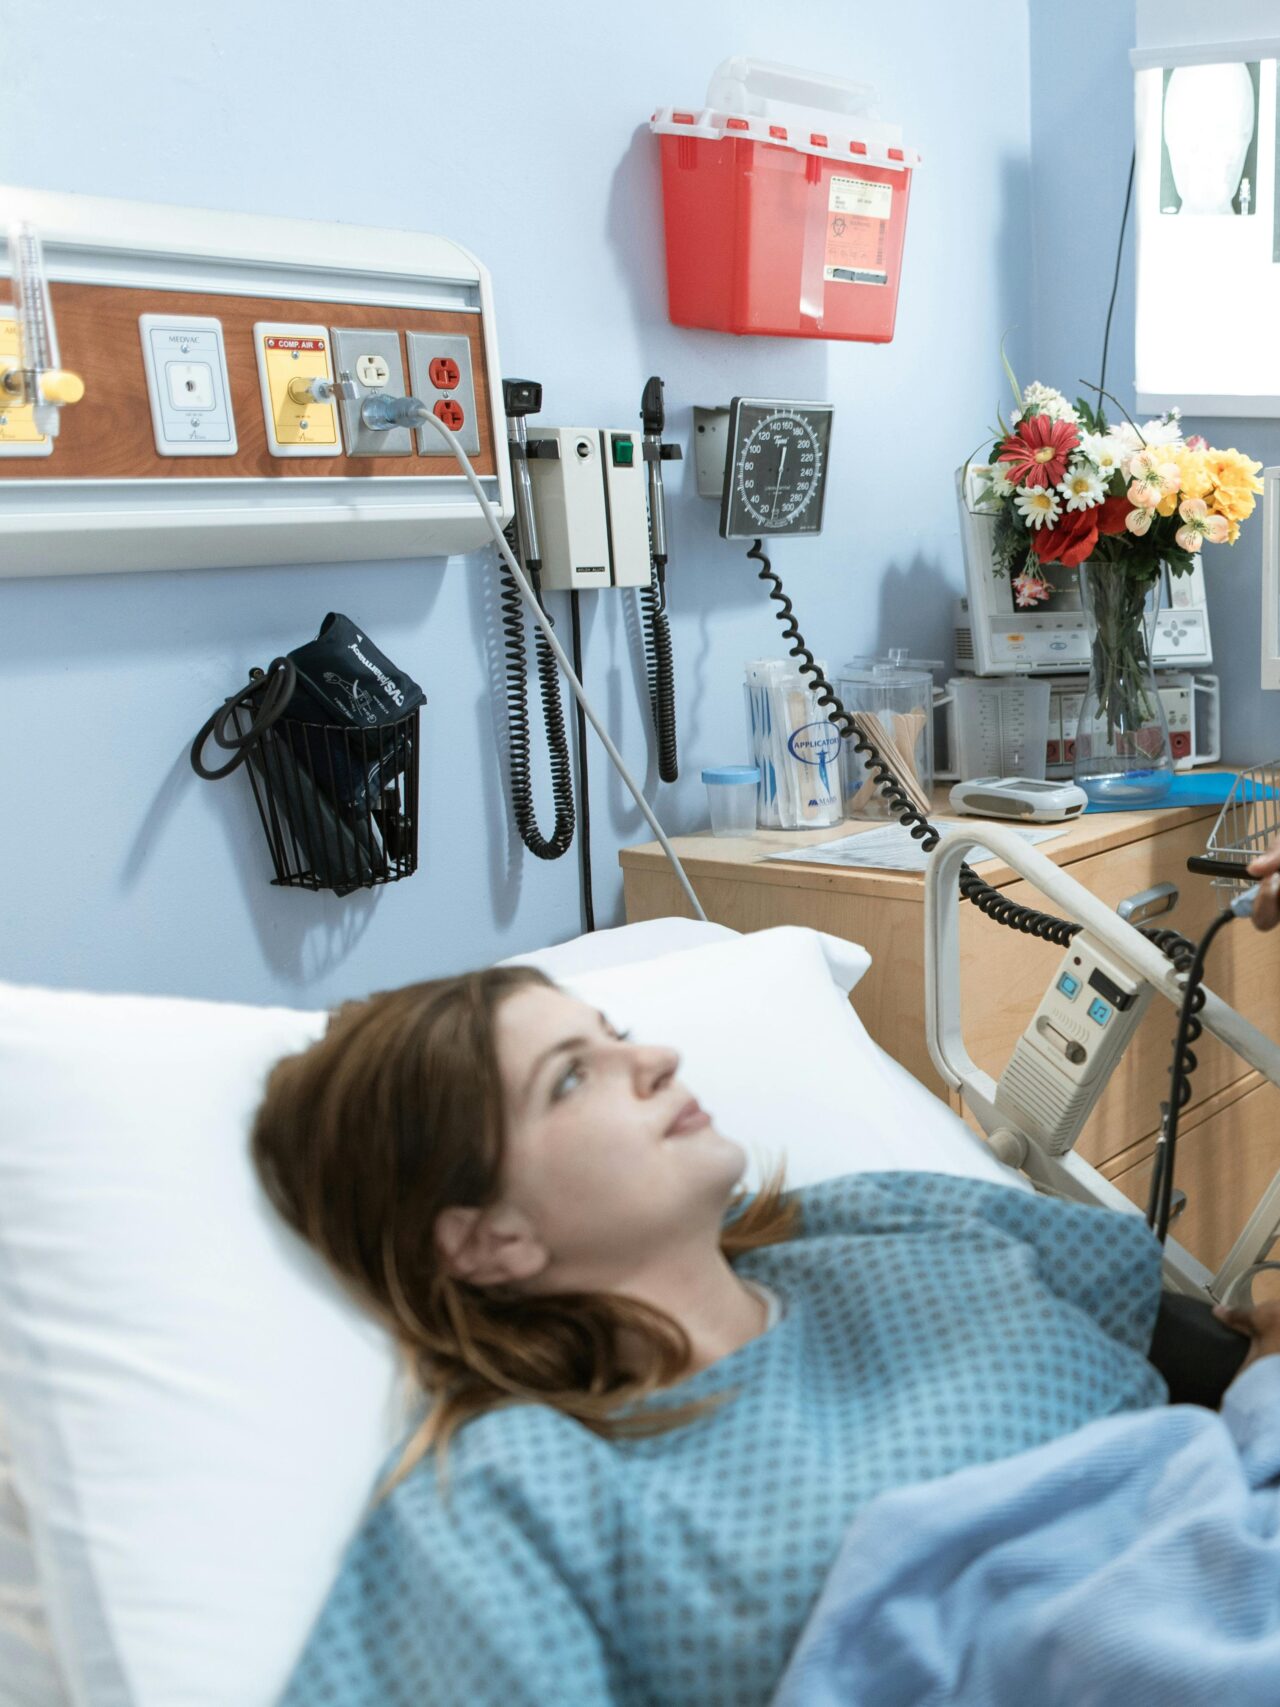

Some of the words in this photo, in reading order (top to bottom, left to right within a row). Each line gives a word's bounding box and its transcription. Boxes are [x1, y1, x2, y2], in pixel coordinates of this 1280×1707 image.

[169, 336, 200, 344] MEDVAC
[278, 340, 299, 348] COMP.
[301, 341, 314, 349] AIR
[769, 422, 781, 431] 140
[782, 421, 793, 430] 160
[758, 431, 771, 440] 120
[792, 427, 804, 436] 180
[797, 439, 810, 449] 200
[749, 444, 762, 454] 100
[800, 453, 814, 462] 220
[744, 462, 754, 471] 80
[800, 468, 814, 477] 240
[796, 481, 810, 491] 260
[750, 495, 760, 503] 40
[789, 493, 803, 502] 280
[760, 504, 769, 513] 20
[781, 503, 795, 512] 300
